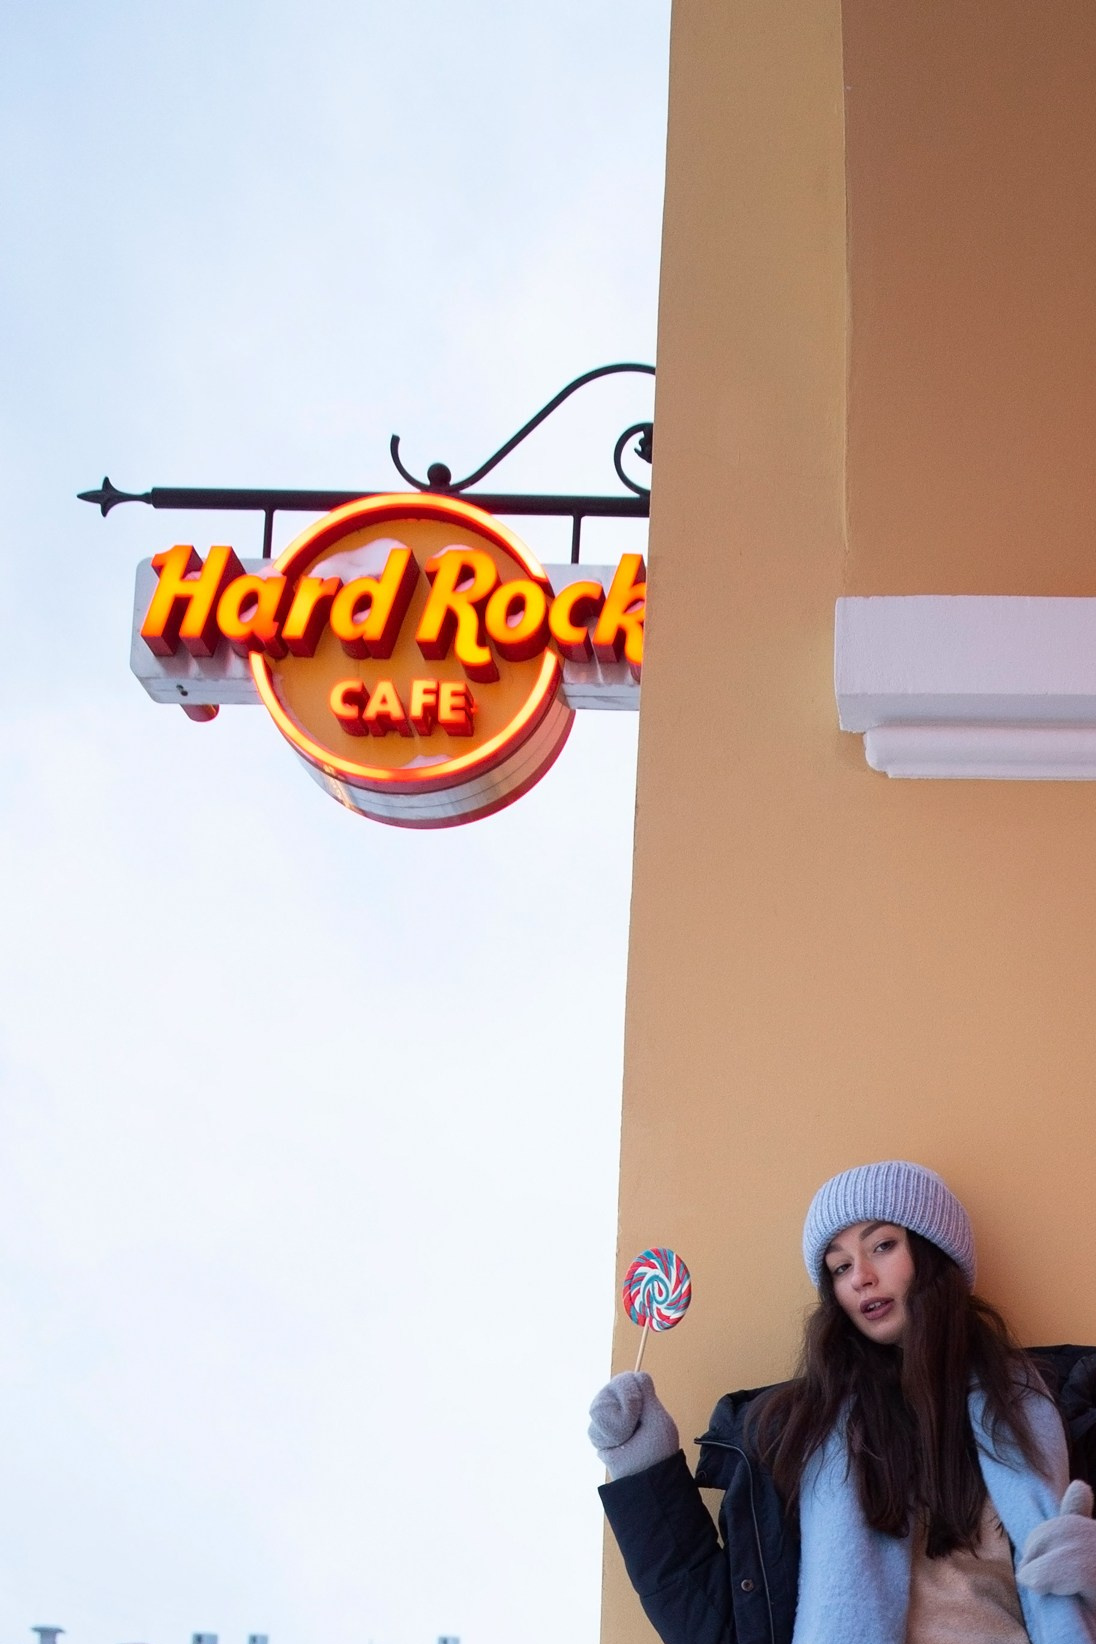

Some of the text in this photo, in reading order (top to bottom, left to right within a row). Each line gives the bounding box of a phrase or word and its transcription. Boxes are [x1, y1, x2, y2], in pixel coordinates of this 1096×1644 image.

[140, 544, 648, 667] Hard Rock
[330, 679, 470, 728] CAFE
